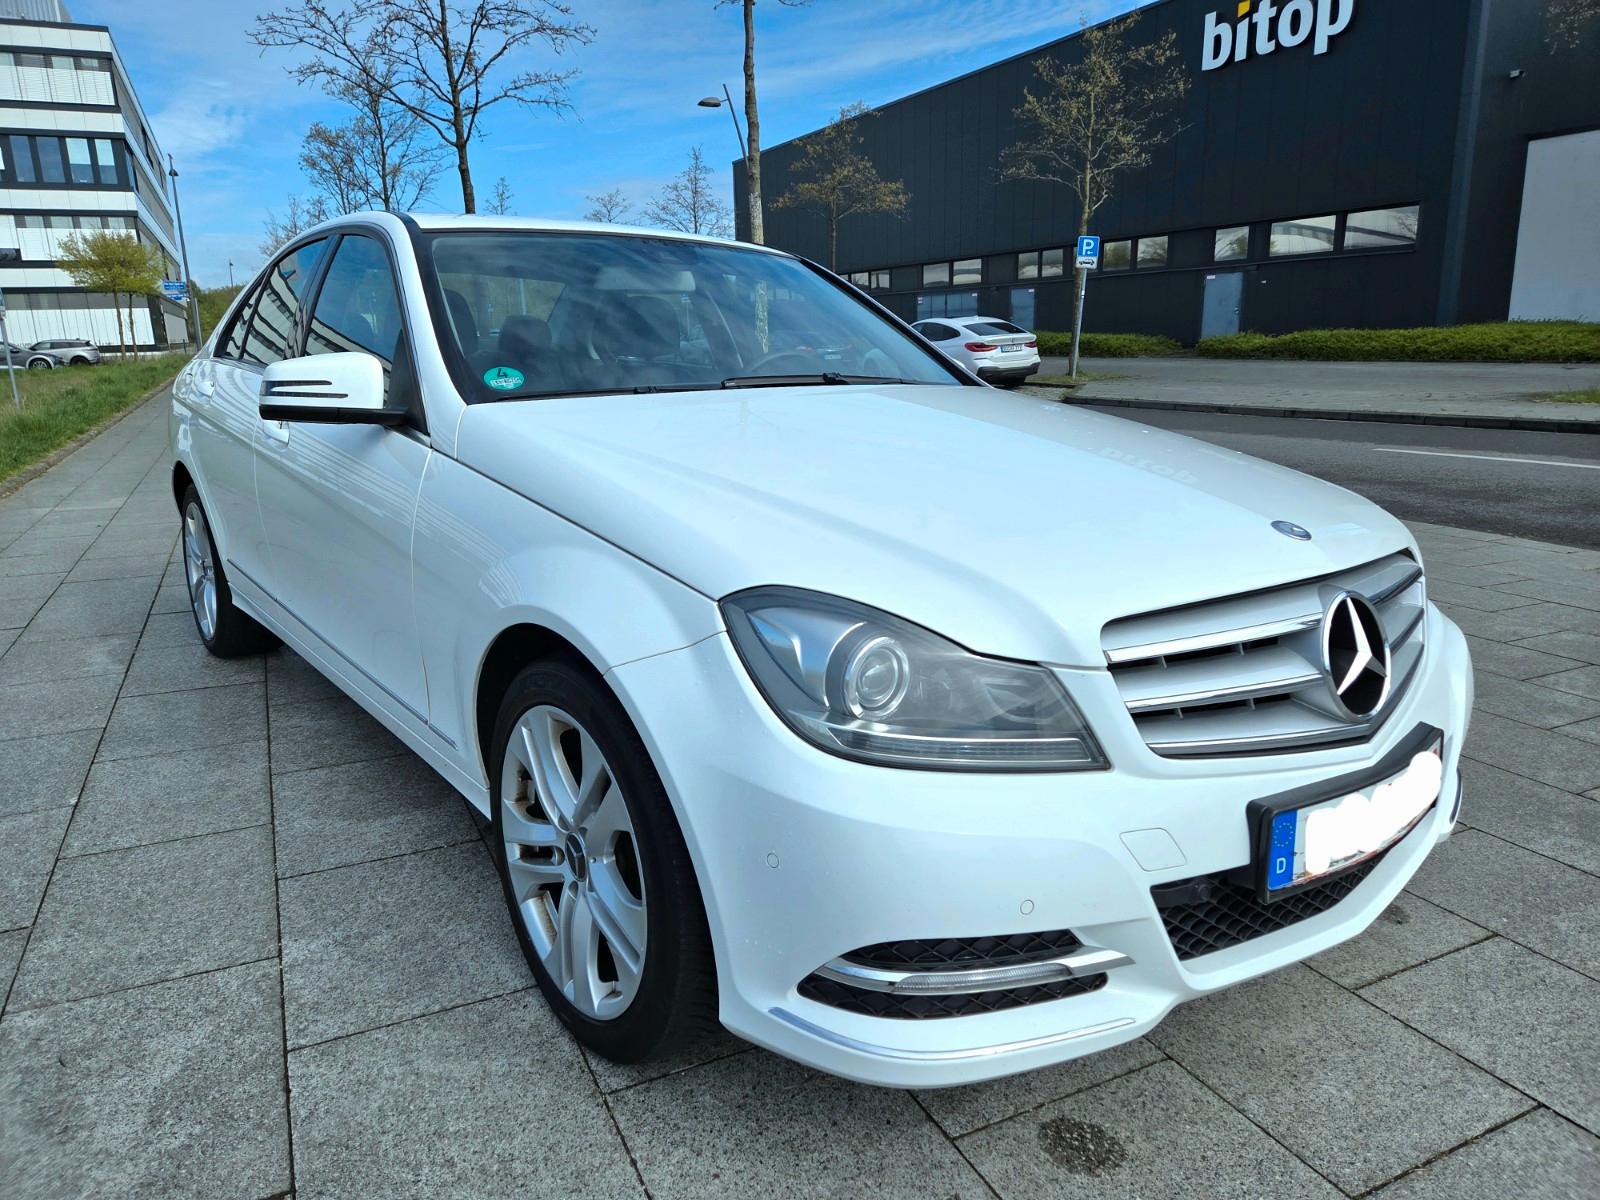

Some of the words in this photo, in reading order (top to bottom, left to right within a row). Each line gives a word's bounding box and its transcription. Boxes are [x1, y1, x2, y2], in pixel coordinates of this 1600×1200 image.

[1201, 0, 1353, 71] bitop
[1082, 239, 1095, 256] P
[497, 367, 509, 378] 4
[1276, 857, 1287, 874] D
